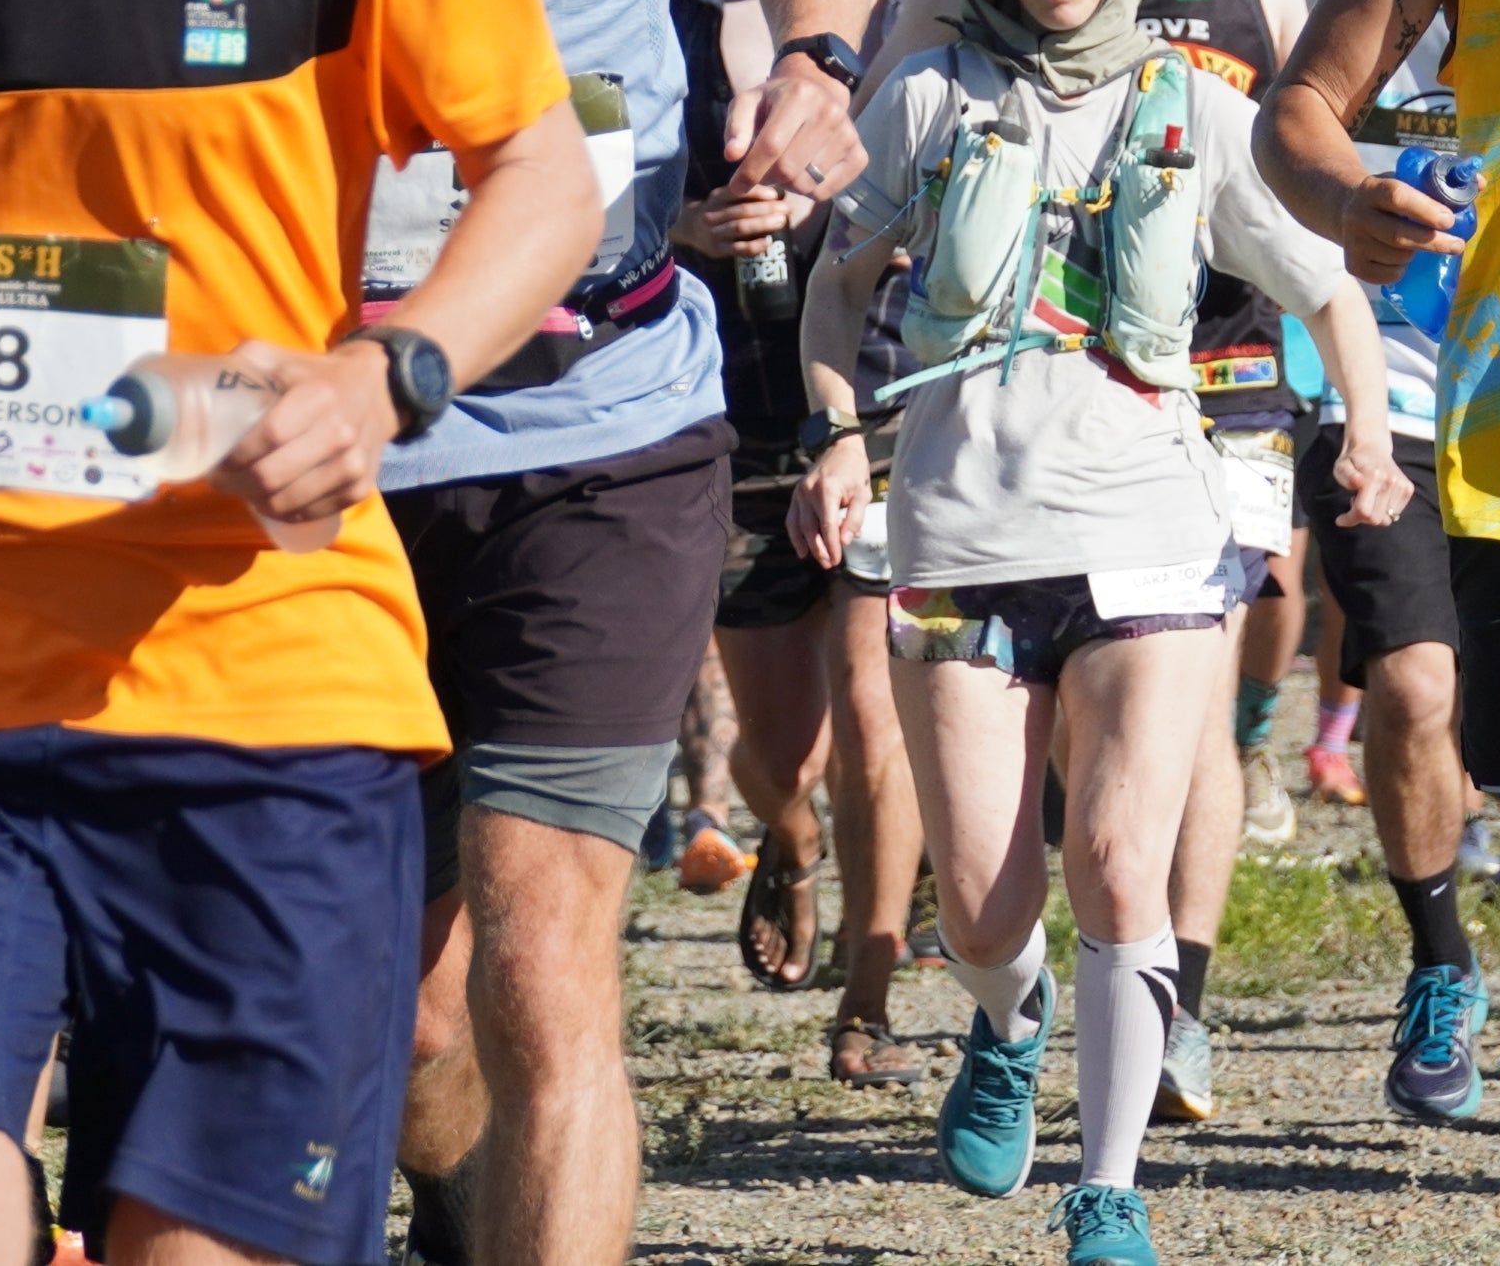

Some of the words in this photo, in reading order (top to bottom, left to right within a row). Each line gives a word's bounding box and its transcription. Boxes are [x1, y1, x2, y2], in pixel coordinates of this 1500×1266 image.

[1137, 17, 1211, 41] OVE
[739, 260, 788, 288] open
[1177, 564, 1229, 582] ZOELER
